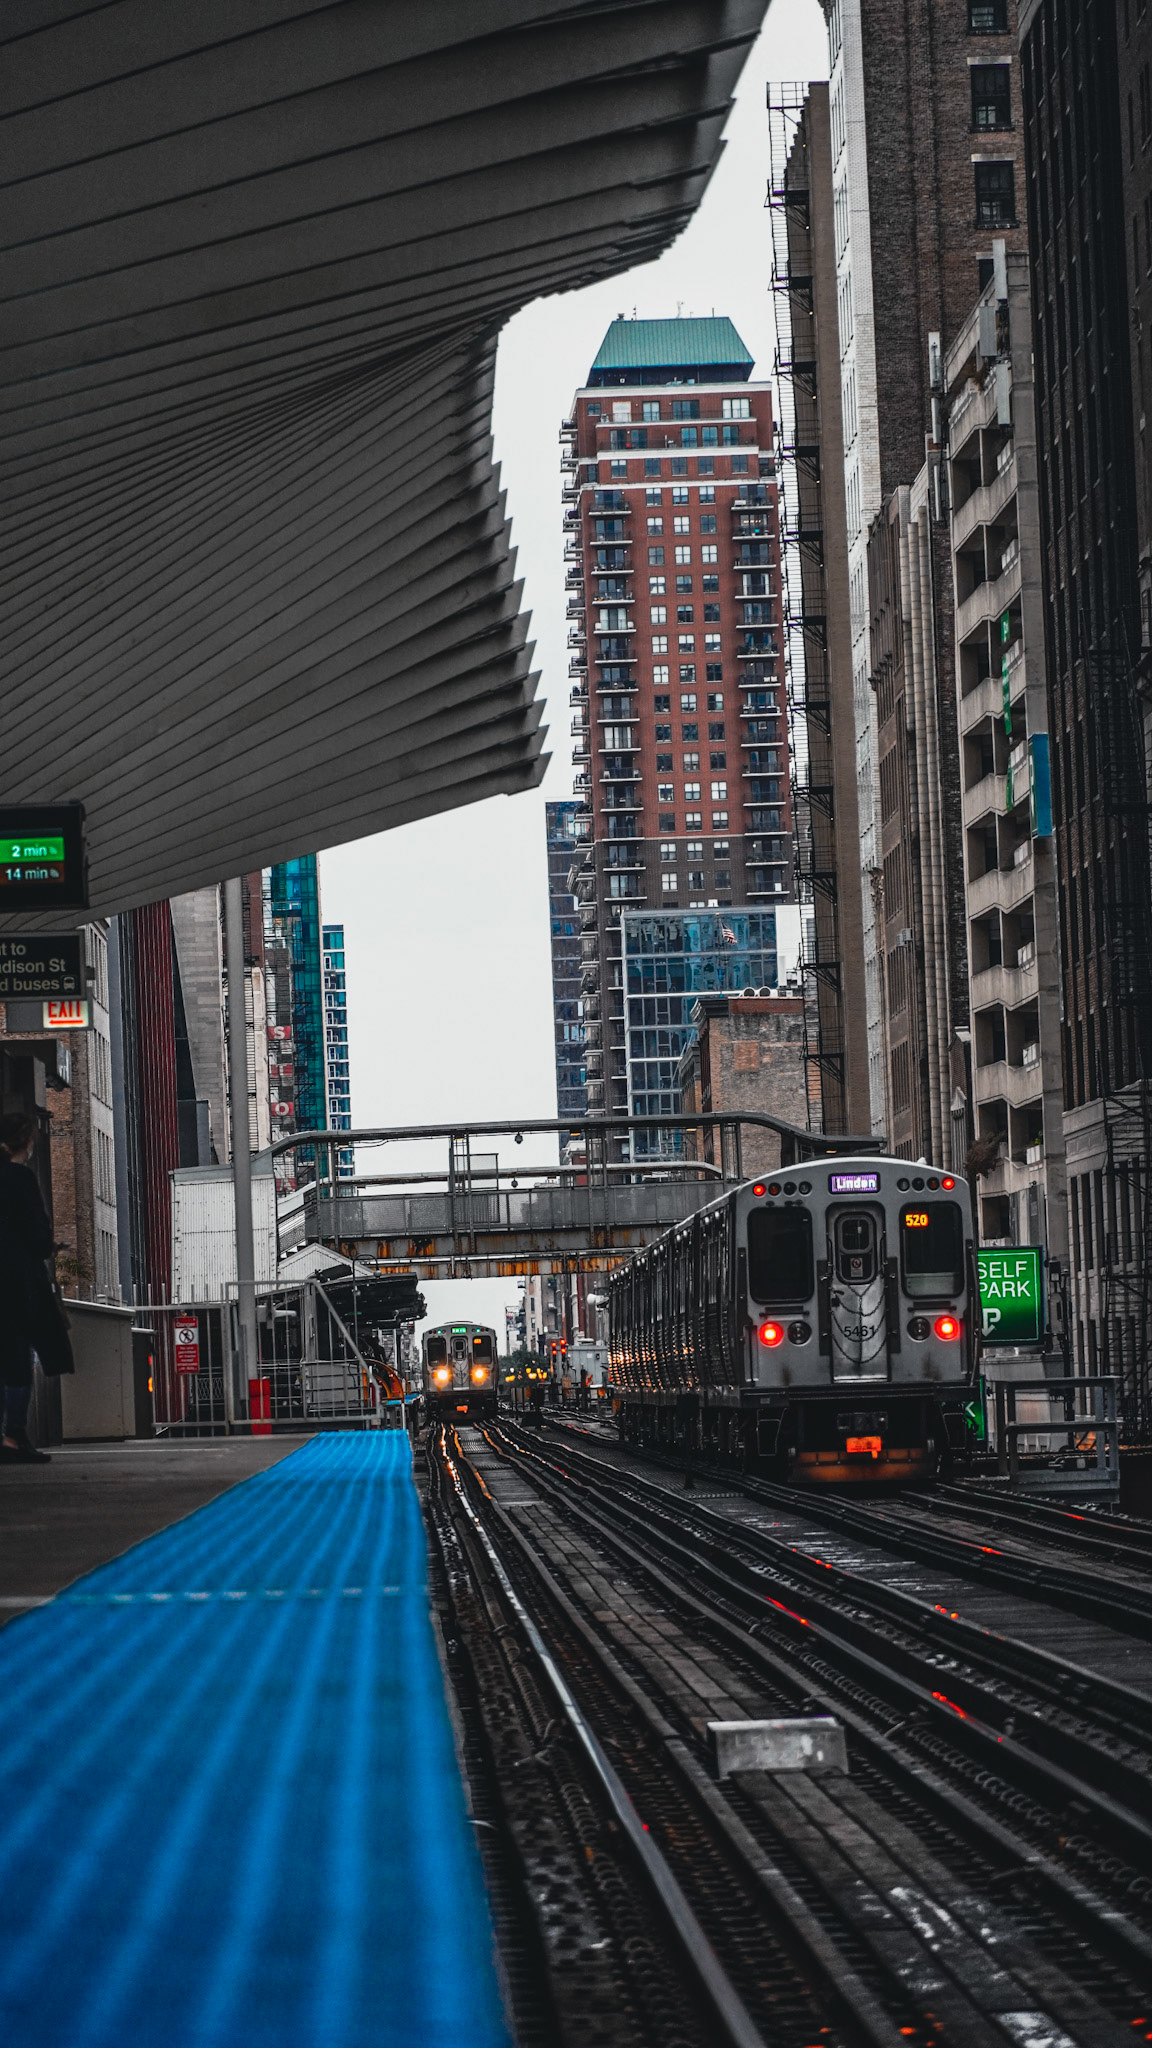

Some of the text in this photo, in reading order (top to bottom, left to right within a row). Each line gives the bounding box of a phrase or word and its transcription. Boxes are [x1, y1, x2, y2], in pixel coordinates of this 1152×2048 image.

[12, 844, 47, 857] 2 min
[5, 867, 49, 880] 14 min
[11, 943, 27, 956] to
[0, 958, 66, 973] dison St
[13, 978, 60, 991] buses
[836, 1177, 877, 1190] Linden
[905, 1213, 929, 1228] 520
[978, 1260, 1028, 1279] SELF
[979, 1280, 1031, 1298] PARK
[844, 1325, 876, 1337] 5461
